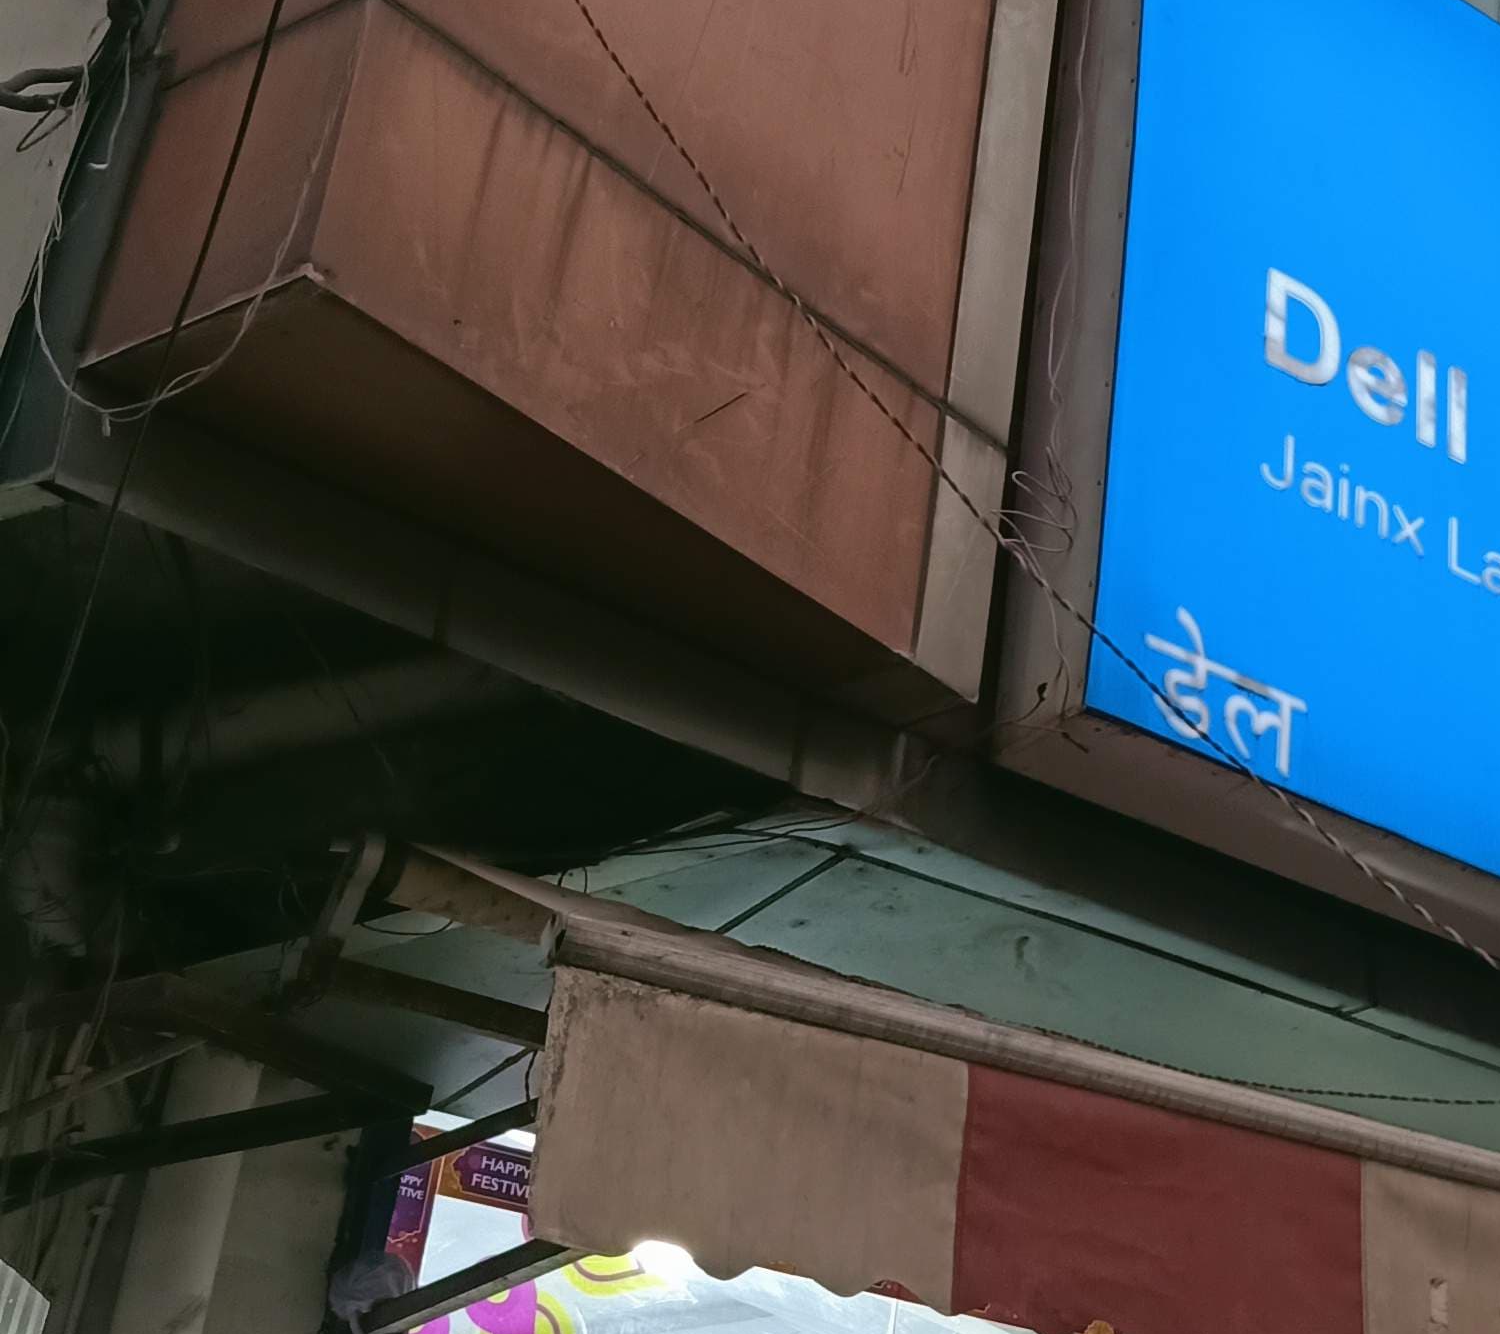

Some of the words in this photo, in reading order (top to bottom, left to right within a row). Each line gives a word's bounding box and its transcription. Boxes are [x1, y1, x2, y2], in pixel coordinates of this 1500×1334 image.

[1262, 266, 1468, 465] Dell
[1259, 434, 1425, 557] Jainx
[1143, 605, 1308, 778] डेल
[471, 1173, 530, 1198] FESTIV
